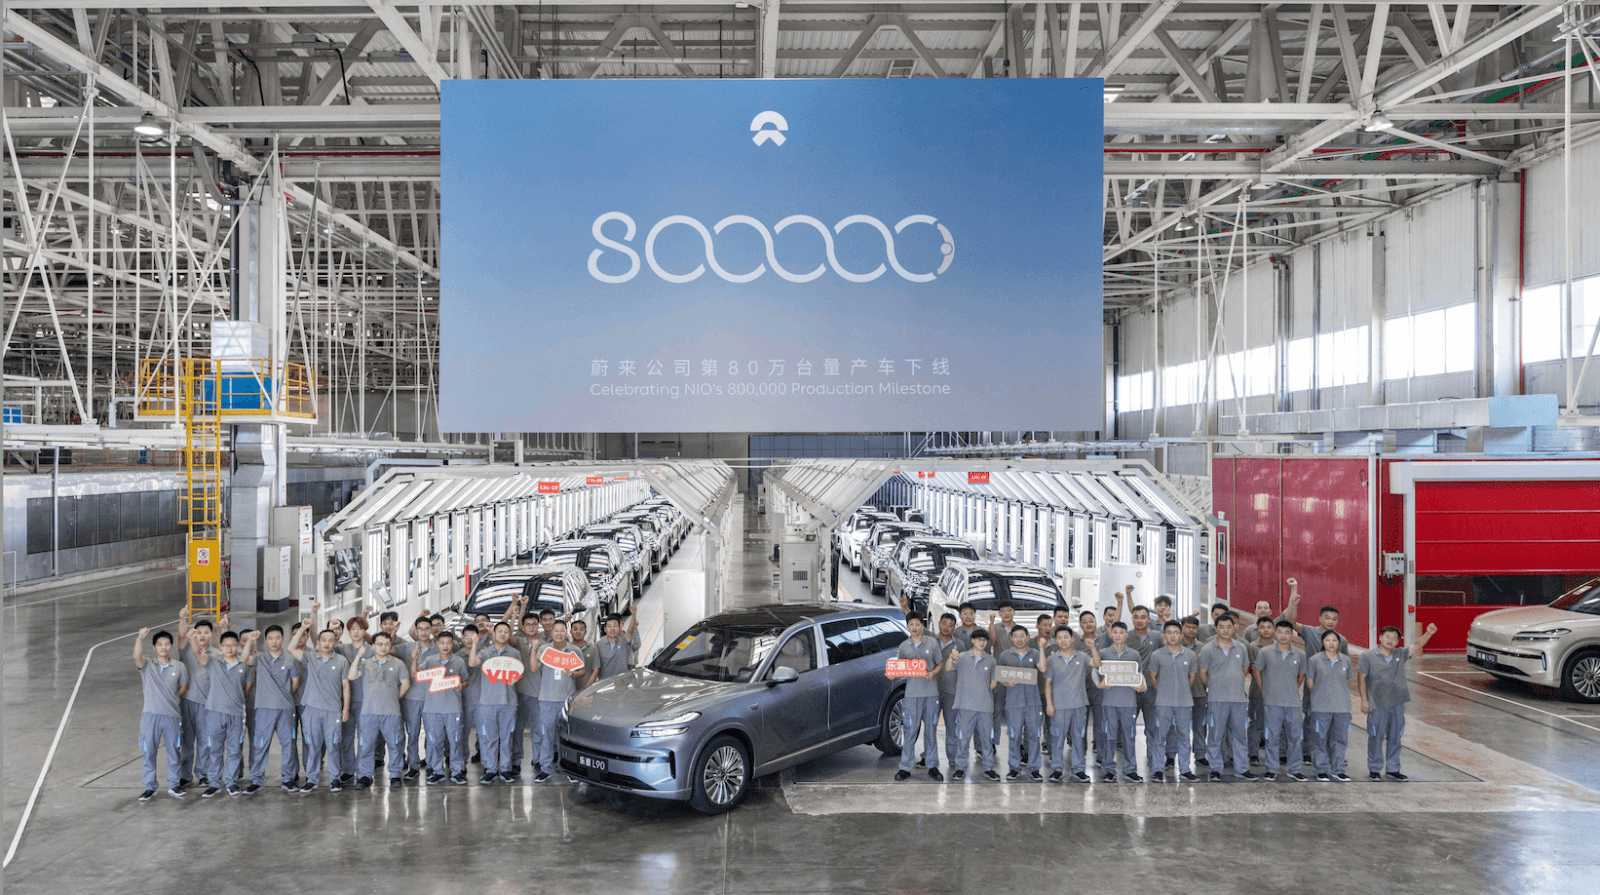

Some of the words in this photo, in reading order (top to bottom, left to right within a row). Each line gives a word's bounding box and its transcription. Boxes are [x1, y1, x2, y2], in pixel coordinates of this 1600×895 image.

[590, 358, 950, 377] 蔚来公司第80万台量产车下线
[590, 383, 679, 399] Celebrating
[684, 383, 723, 396] NIO's
[727, 382, 787, 397] 800,000
[791, 382, 874, 396] Production
[879, 382, 951, 396] Milestone
[486, 669, 521, 685] VIP
